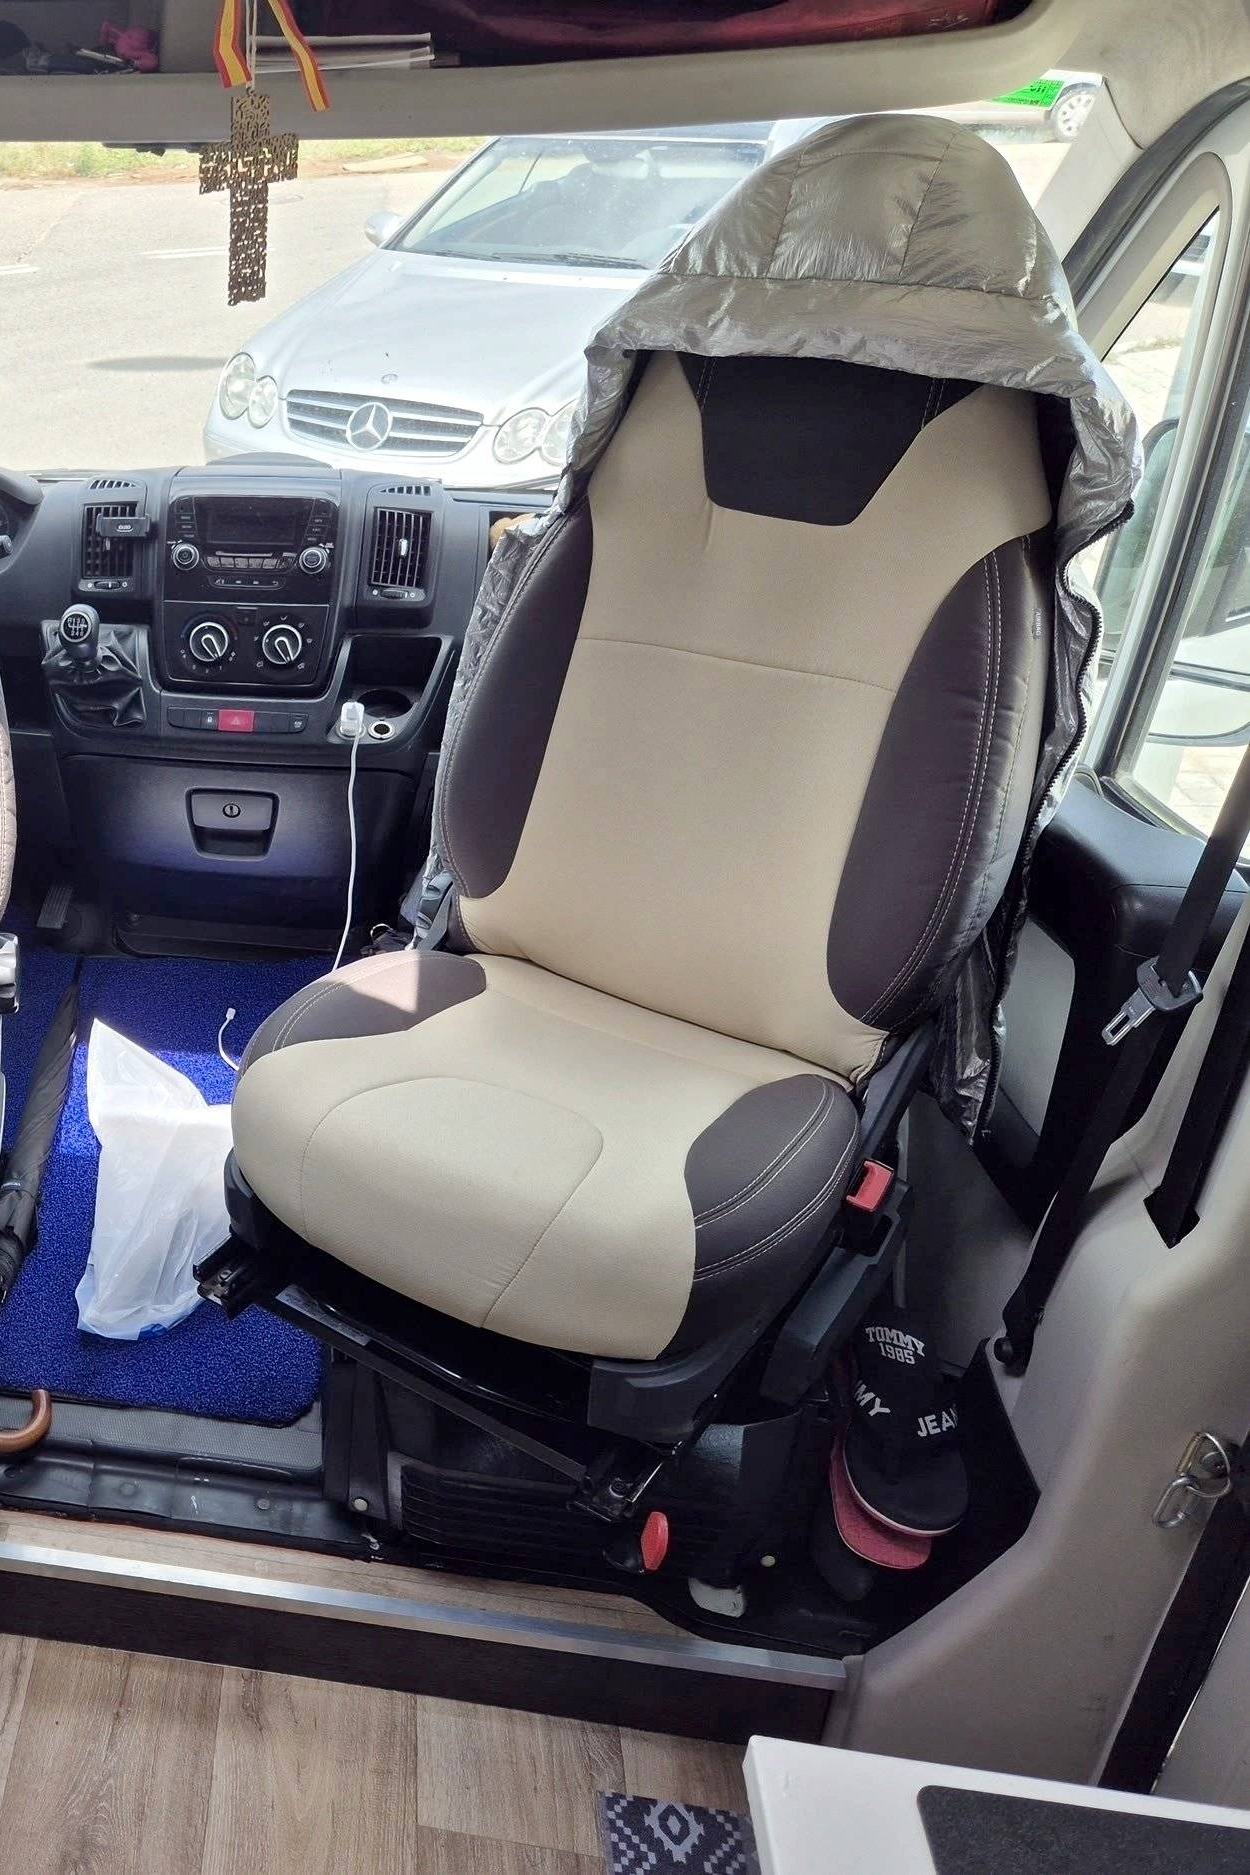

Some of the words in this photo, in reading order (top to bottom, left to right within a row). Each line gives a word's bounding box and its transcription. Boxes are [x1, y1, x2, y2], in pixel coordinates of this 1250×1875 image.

[865, 1326, 926, 1357] TOMMY
[878, 1342, 916, 1365] 1985
[854, 1380, 891, 1417] MY
